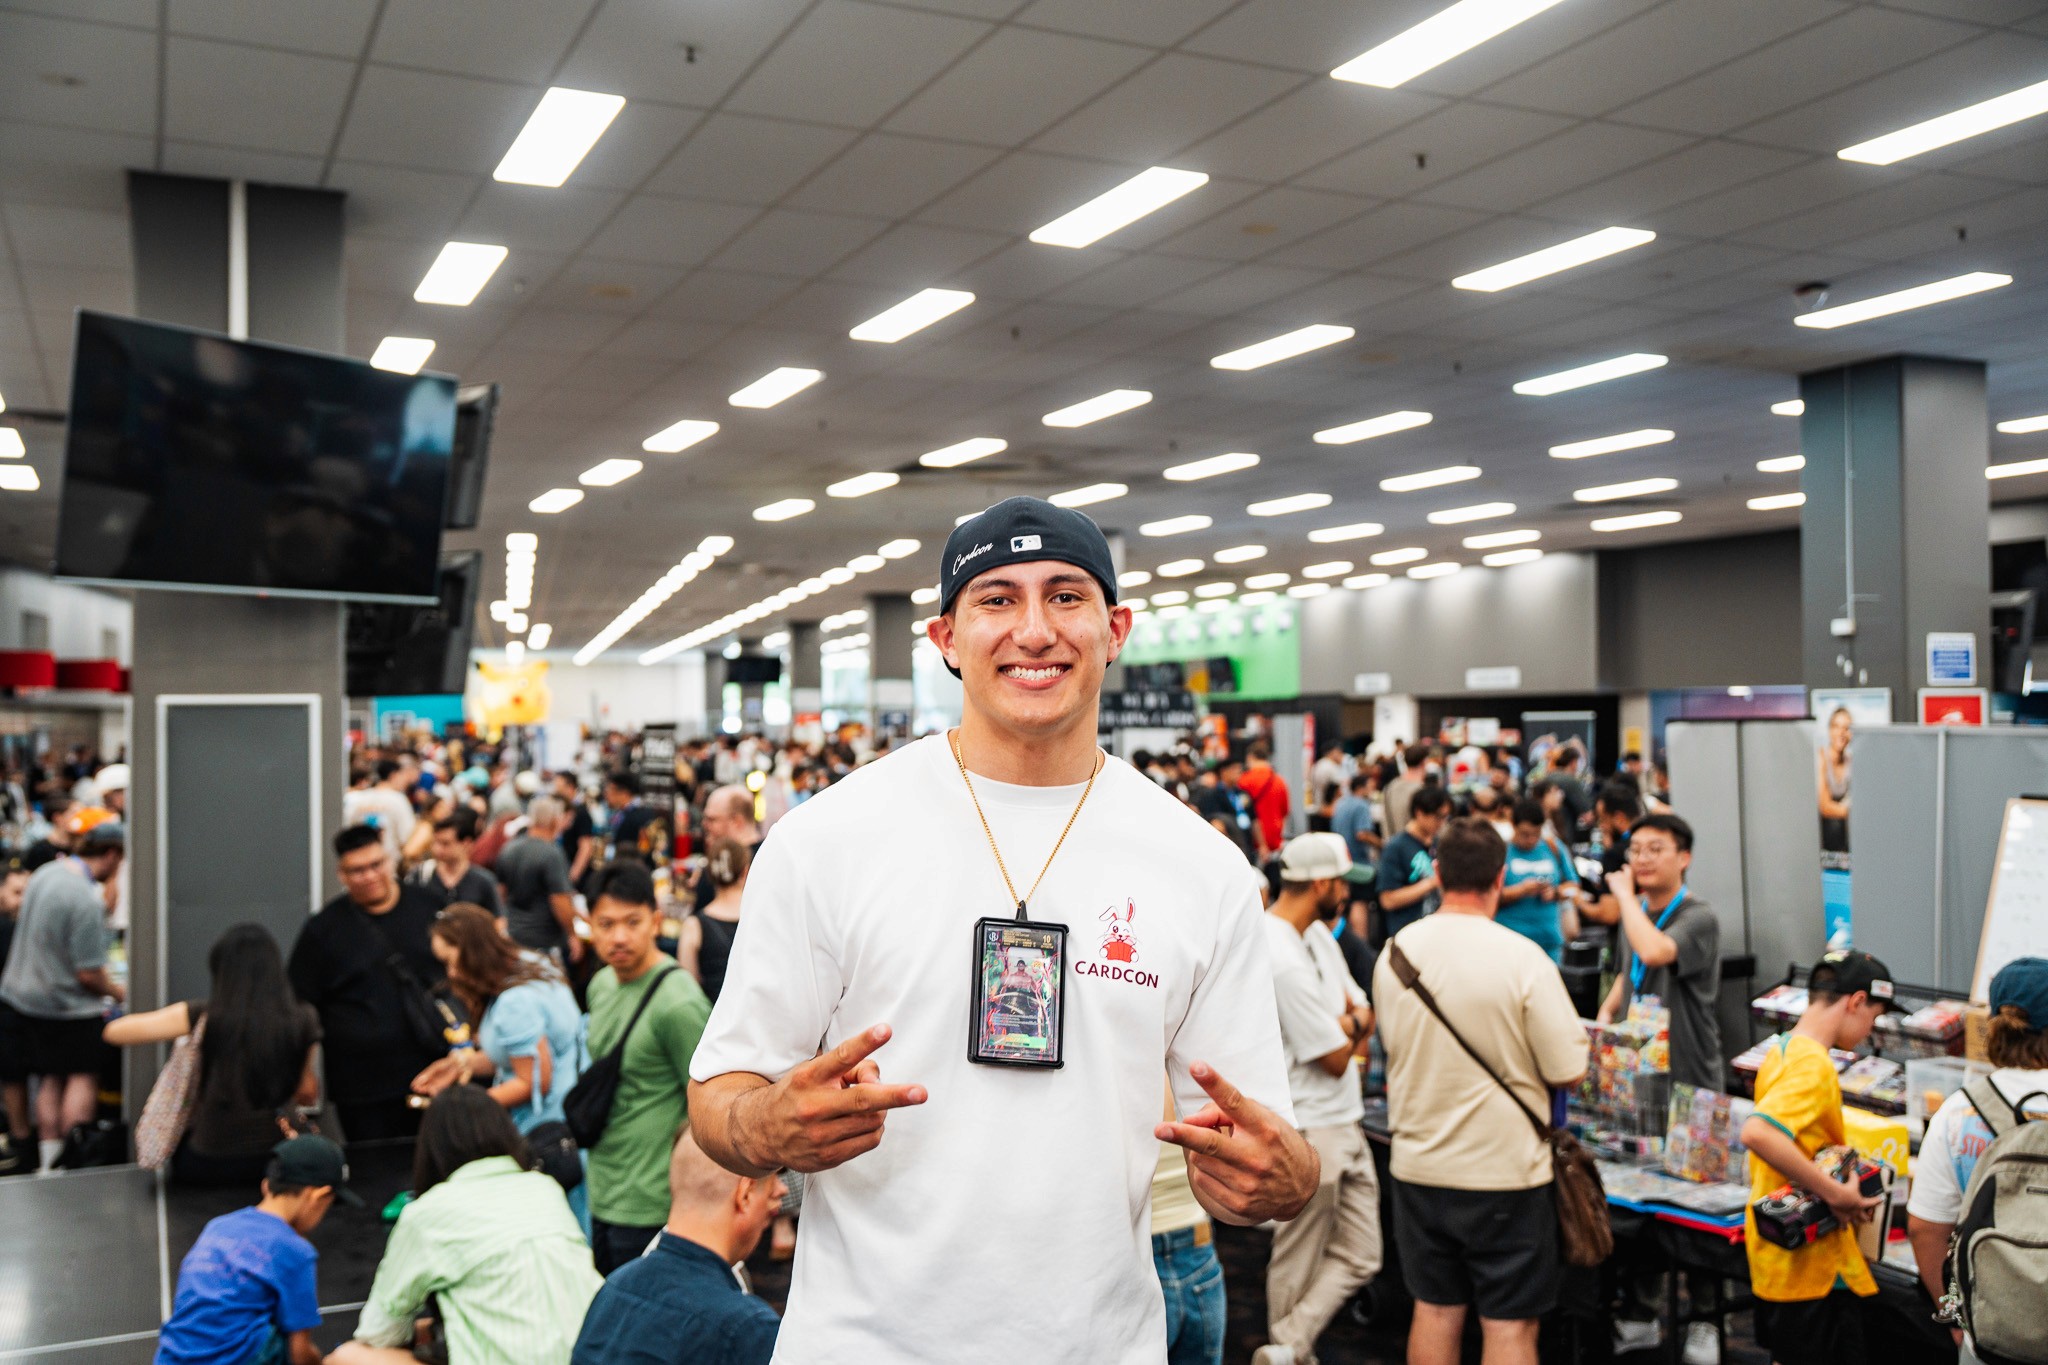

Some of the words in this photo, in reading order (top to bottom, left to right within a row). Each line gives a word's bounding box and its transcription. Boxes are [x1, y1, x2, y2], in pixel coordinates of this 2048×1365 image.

[953, 543, 993, 575] Cardcon
[1042, 934, 1051, 944] 10
[1075, 961, 1158, 988] CARDCON
